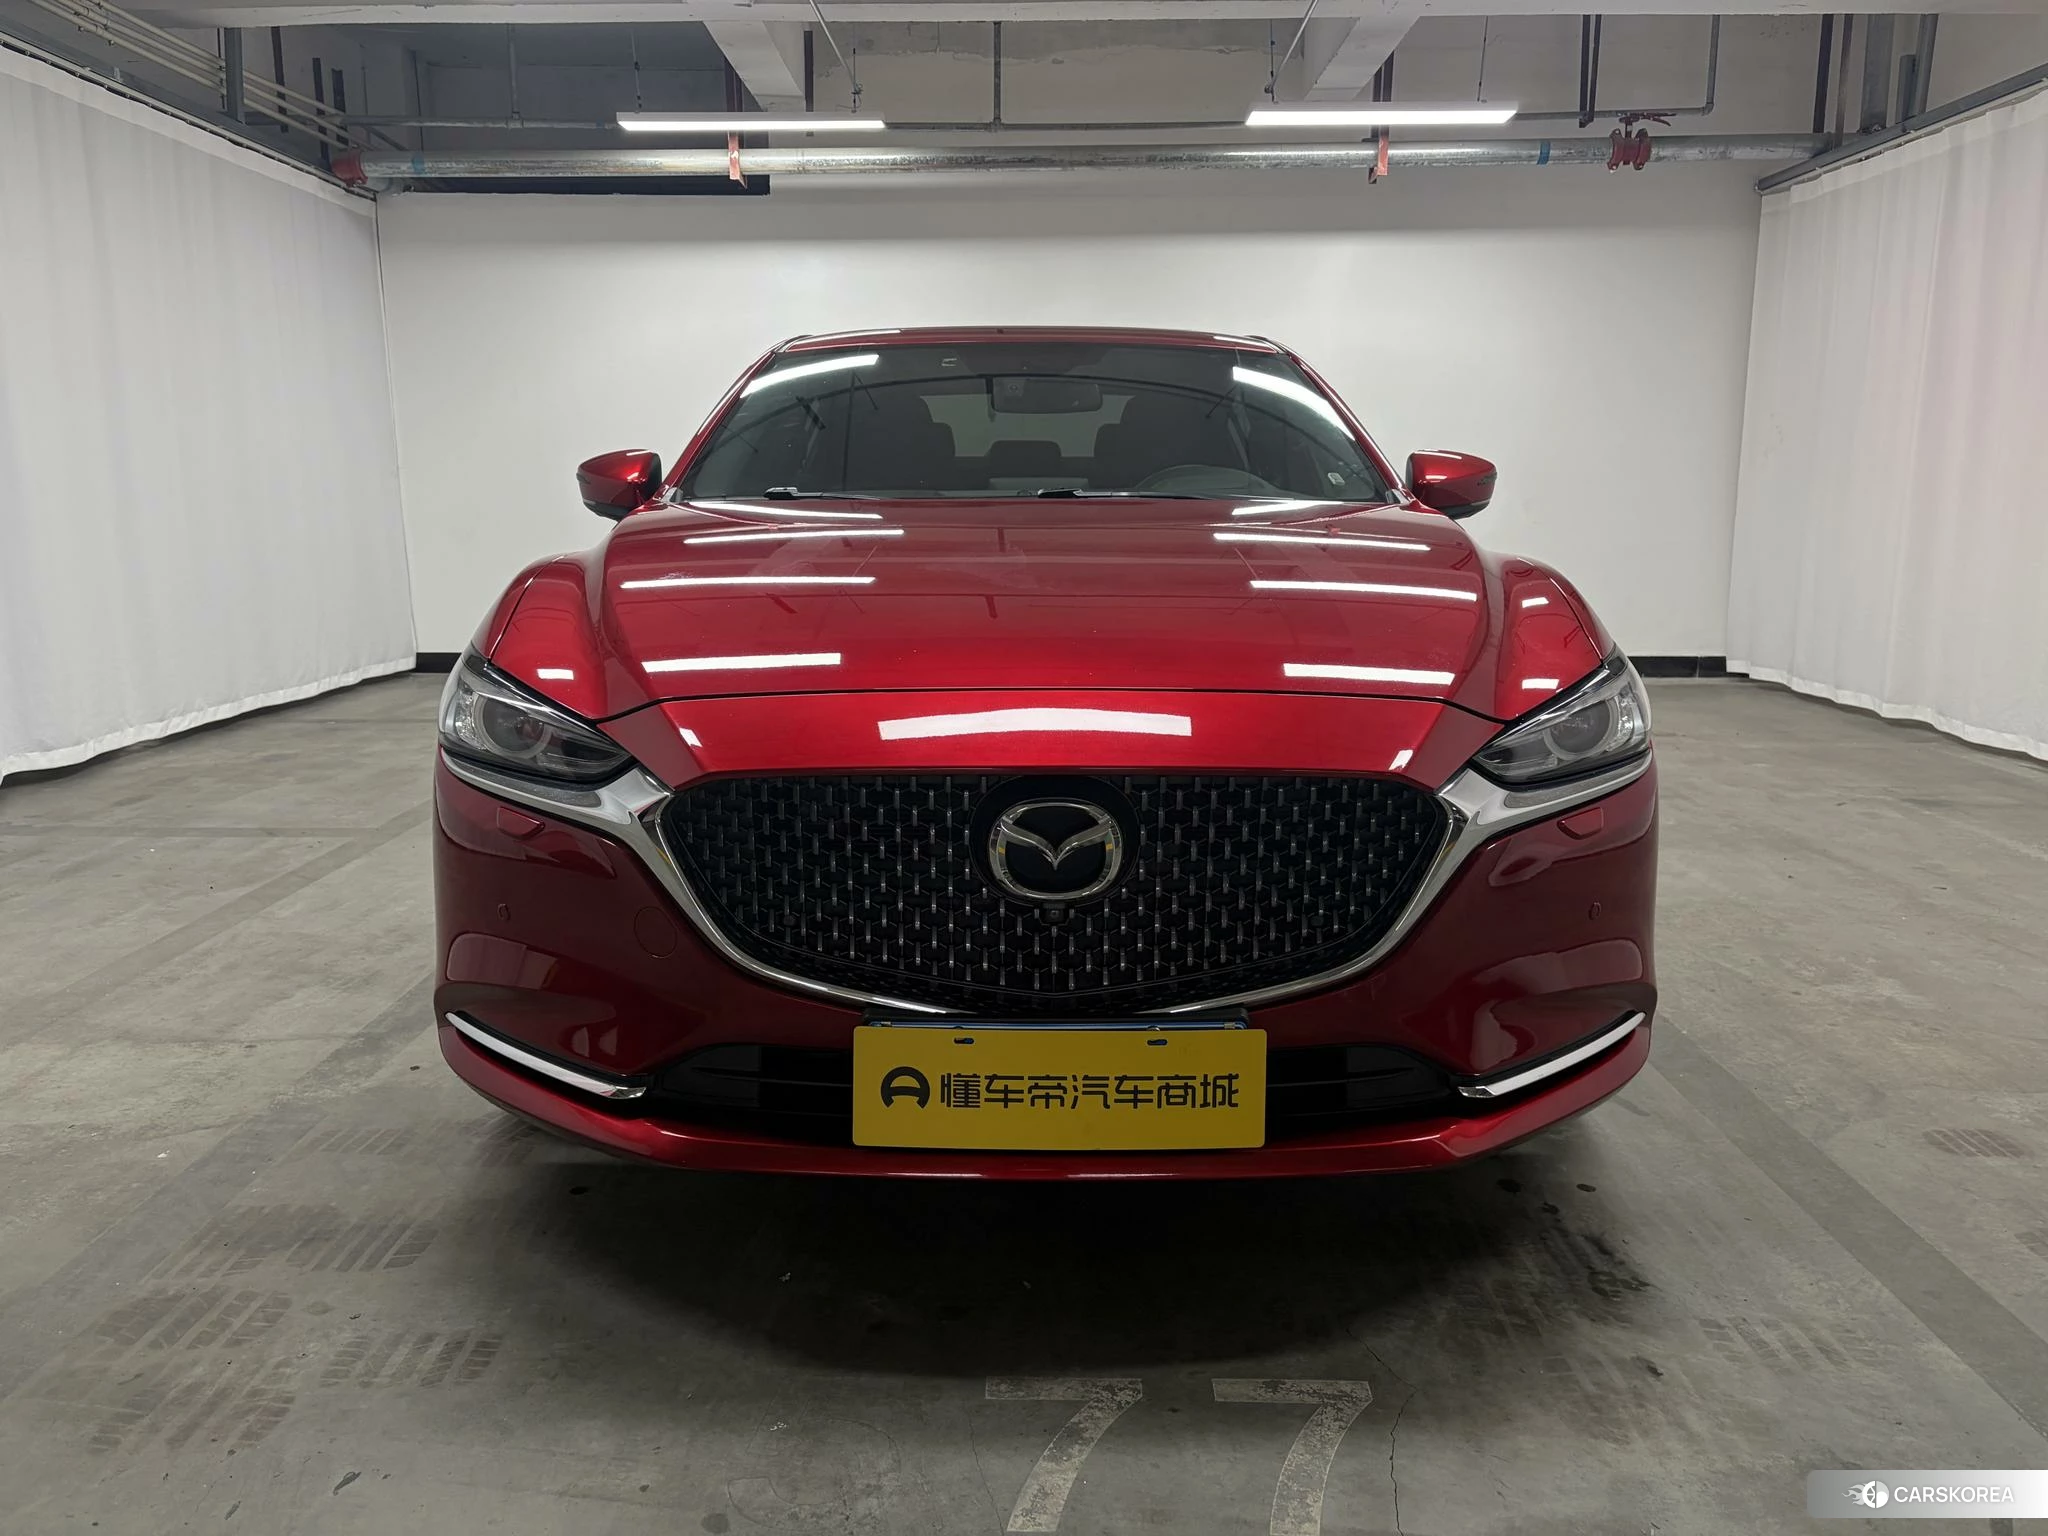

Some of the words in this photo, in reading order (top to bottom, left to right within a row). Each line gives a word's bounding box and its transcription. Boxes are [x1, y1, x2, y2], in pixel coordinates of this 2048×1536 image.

[940, 1073, 1240, 1109] 懂车帝汽车商城
[985, 1377, 1373, 1535] 77
